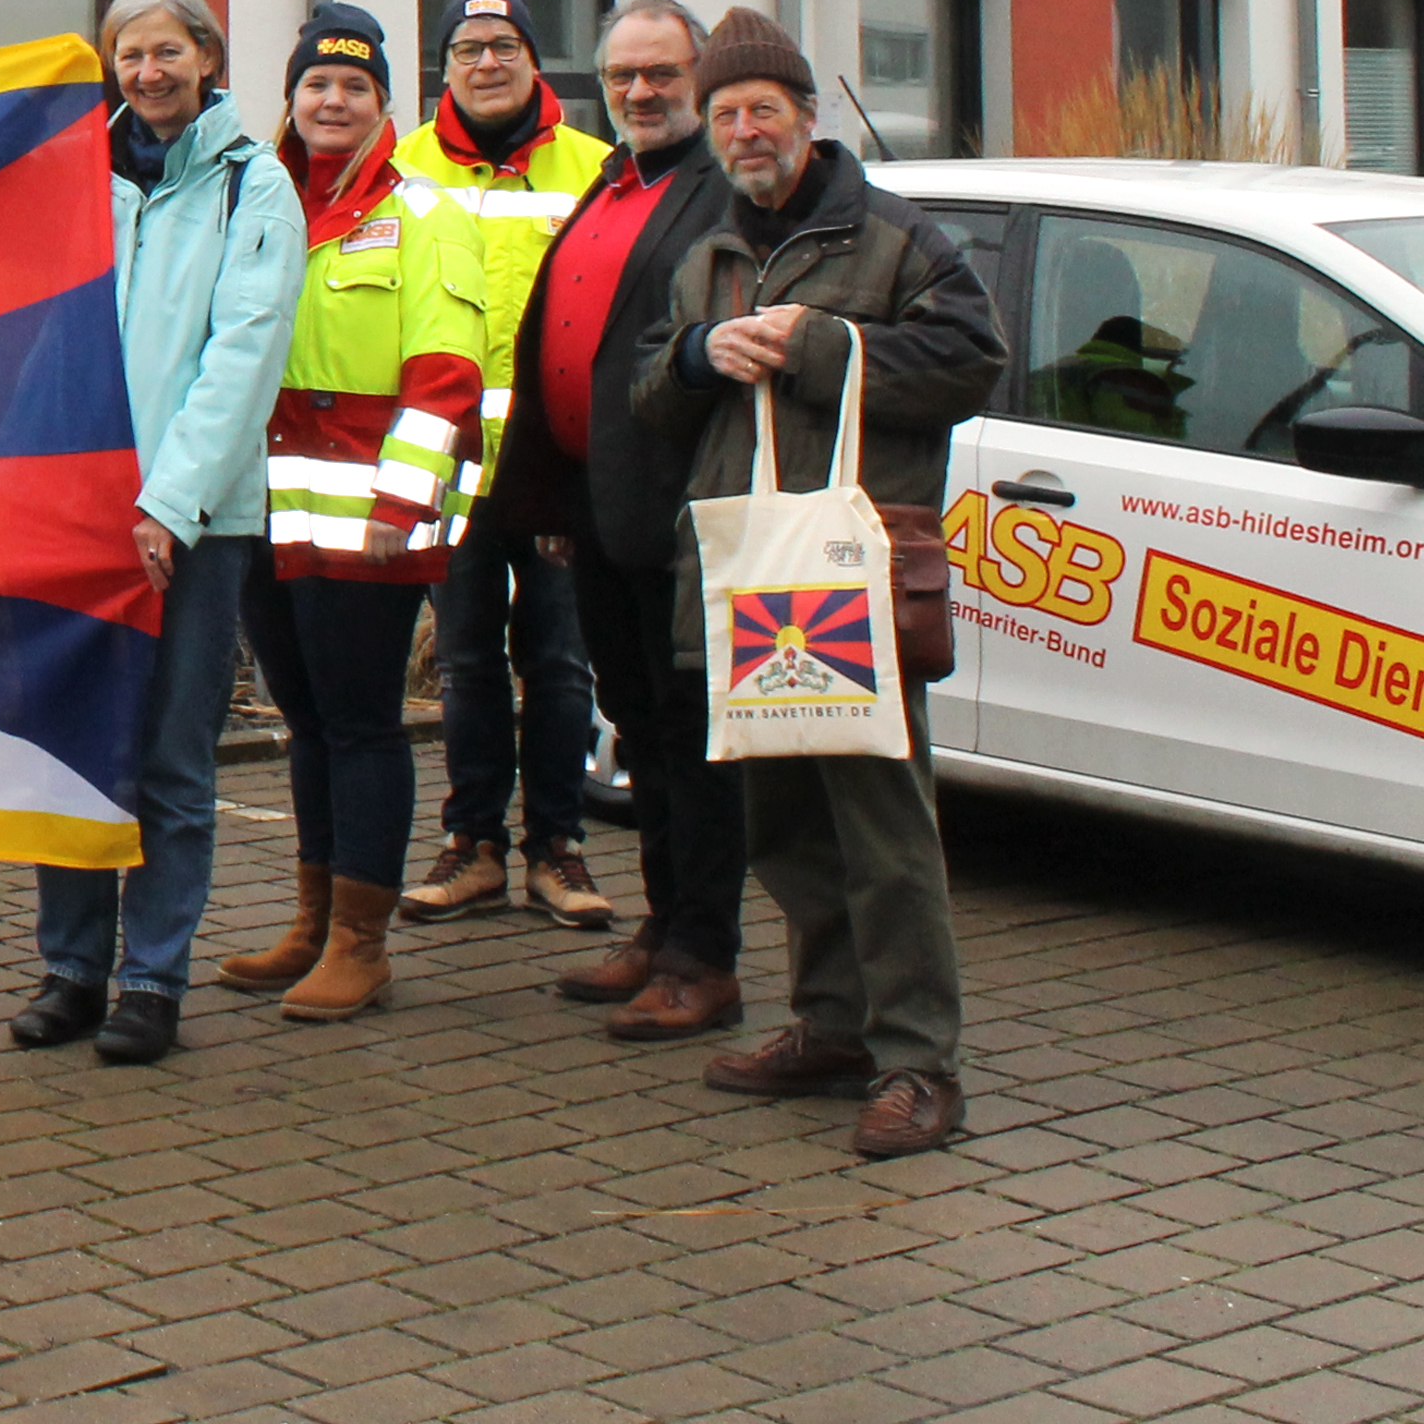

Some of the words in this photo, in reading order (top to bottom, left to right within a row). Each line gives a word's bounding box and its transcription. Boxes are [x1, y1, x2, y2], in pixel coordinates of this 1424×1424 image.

[330, 38, 372, 60] ASB
[941, 488, 1126, 626] ASB
[1121, 494, 1424, 560] www.asb-hildesheim.or
[951, 600, 1106, 669] amariter-Bund
[1160, 574, 1320, 676] Soziale
